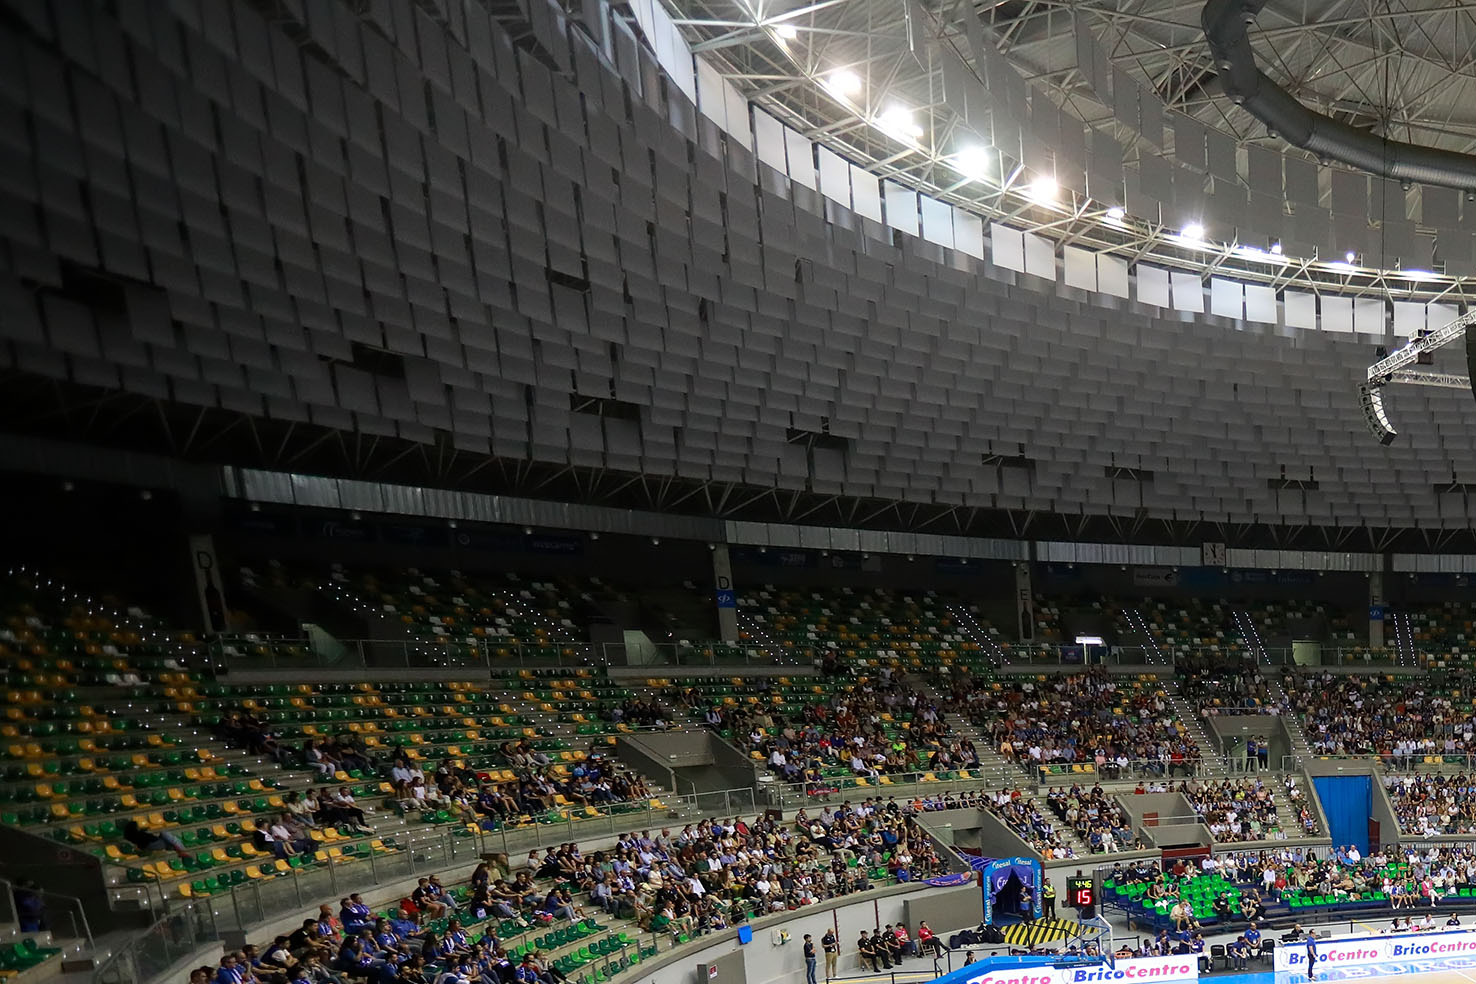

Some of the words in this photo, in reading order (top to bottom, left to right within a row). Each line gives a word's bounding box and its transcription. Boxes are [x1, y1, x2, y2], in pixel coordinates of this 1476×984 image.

[197, 552, 214, 570] D
[719, 576, 730, 590] D
[1077, 890, 1092, 904] 15
[1288, 946, 1378, 965] BrcoCentro
[1393, 940, 1476, 957] BricoCentro
[1074, 963, 1190, 983] BricoCentro
